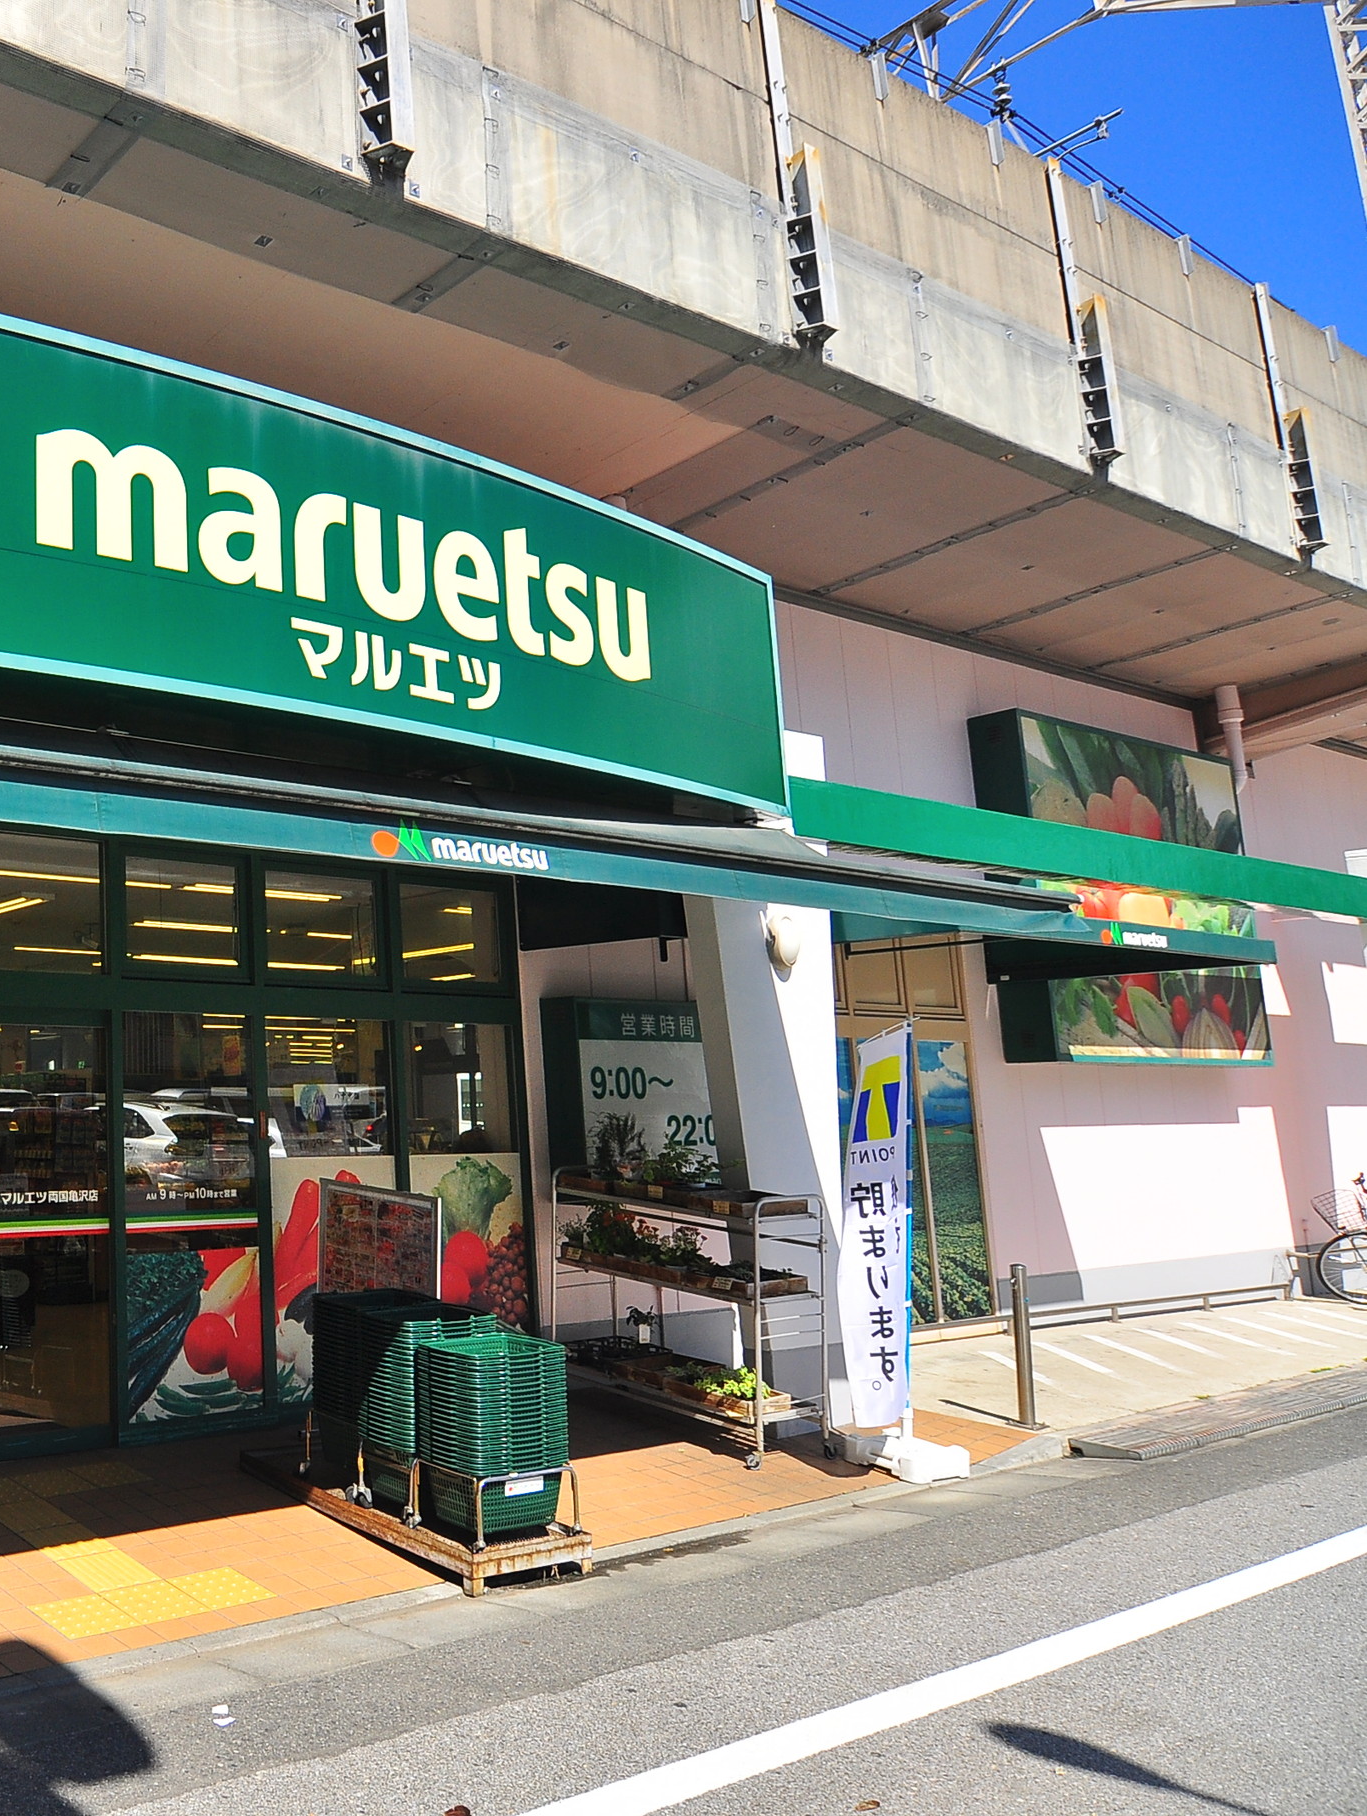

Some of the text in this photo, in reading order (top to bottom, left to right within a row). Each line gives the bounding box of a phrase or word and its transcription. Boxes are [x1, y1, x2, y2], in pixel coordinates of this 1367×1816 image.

[35, 428, 653, 682] maruetsu
[290, 617, 502, 711] マルエツ
[431, 837, 549, 870] maruetsu
[1122, 932, 1168, 948] maruetsu
[621, 1013, 695, 1038] 営業時間
